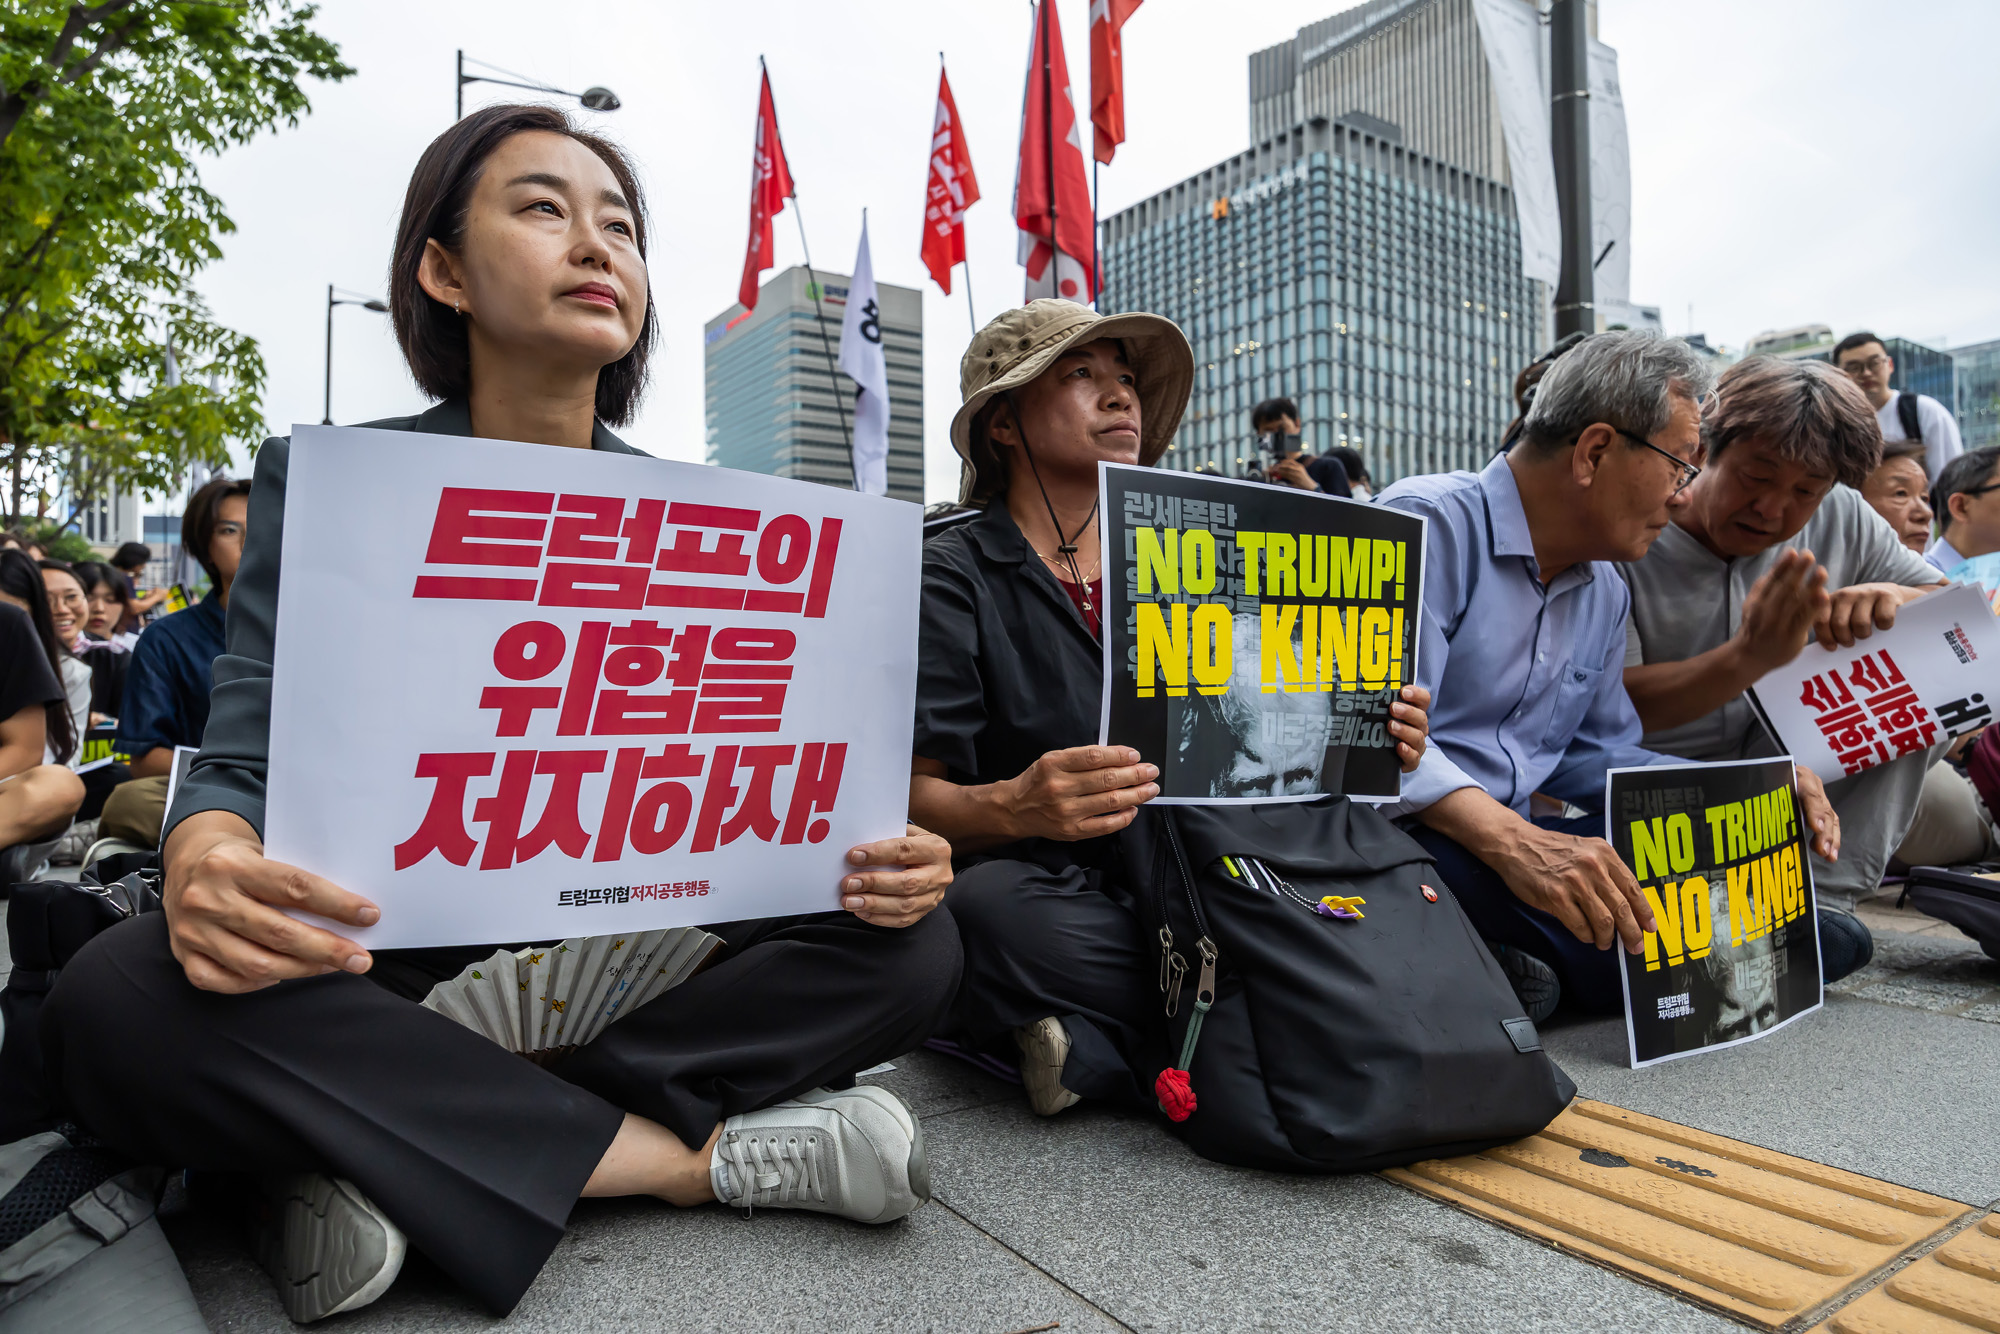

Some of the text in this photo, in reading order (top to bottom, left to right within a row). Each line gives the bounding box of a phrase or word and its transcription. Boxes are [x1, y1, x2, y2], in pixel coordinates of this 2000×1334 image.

[413, 487, 843, 619] 트럼프의
[1136, 527, 1216, 595] NO
[1236, 531, 1407, 600] TRUMP!
[479, 620, 797, 737] 위협을
[1136, 603, 1233, 698] NO
[1261, 604, 1405, 694] KING!
[395, 742, 848, 871] 저지하자!
[1630, 783, 1798, 882] NO TRUMP!
[1642, 841, 1806, 973] NO KING!
